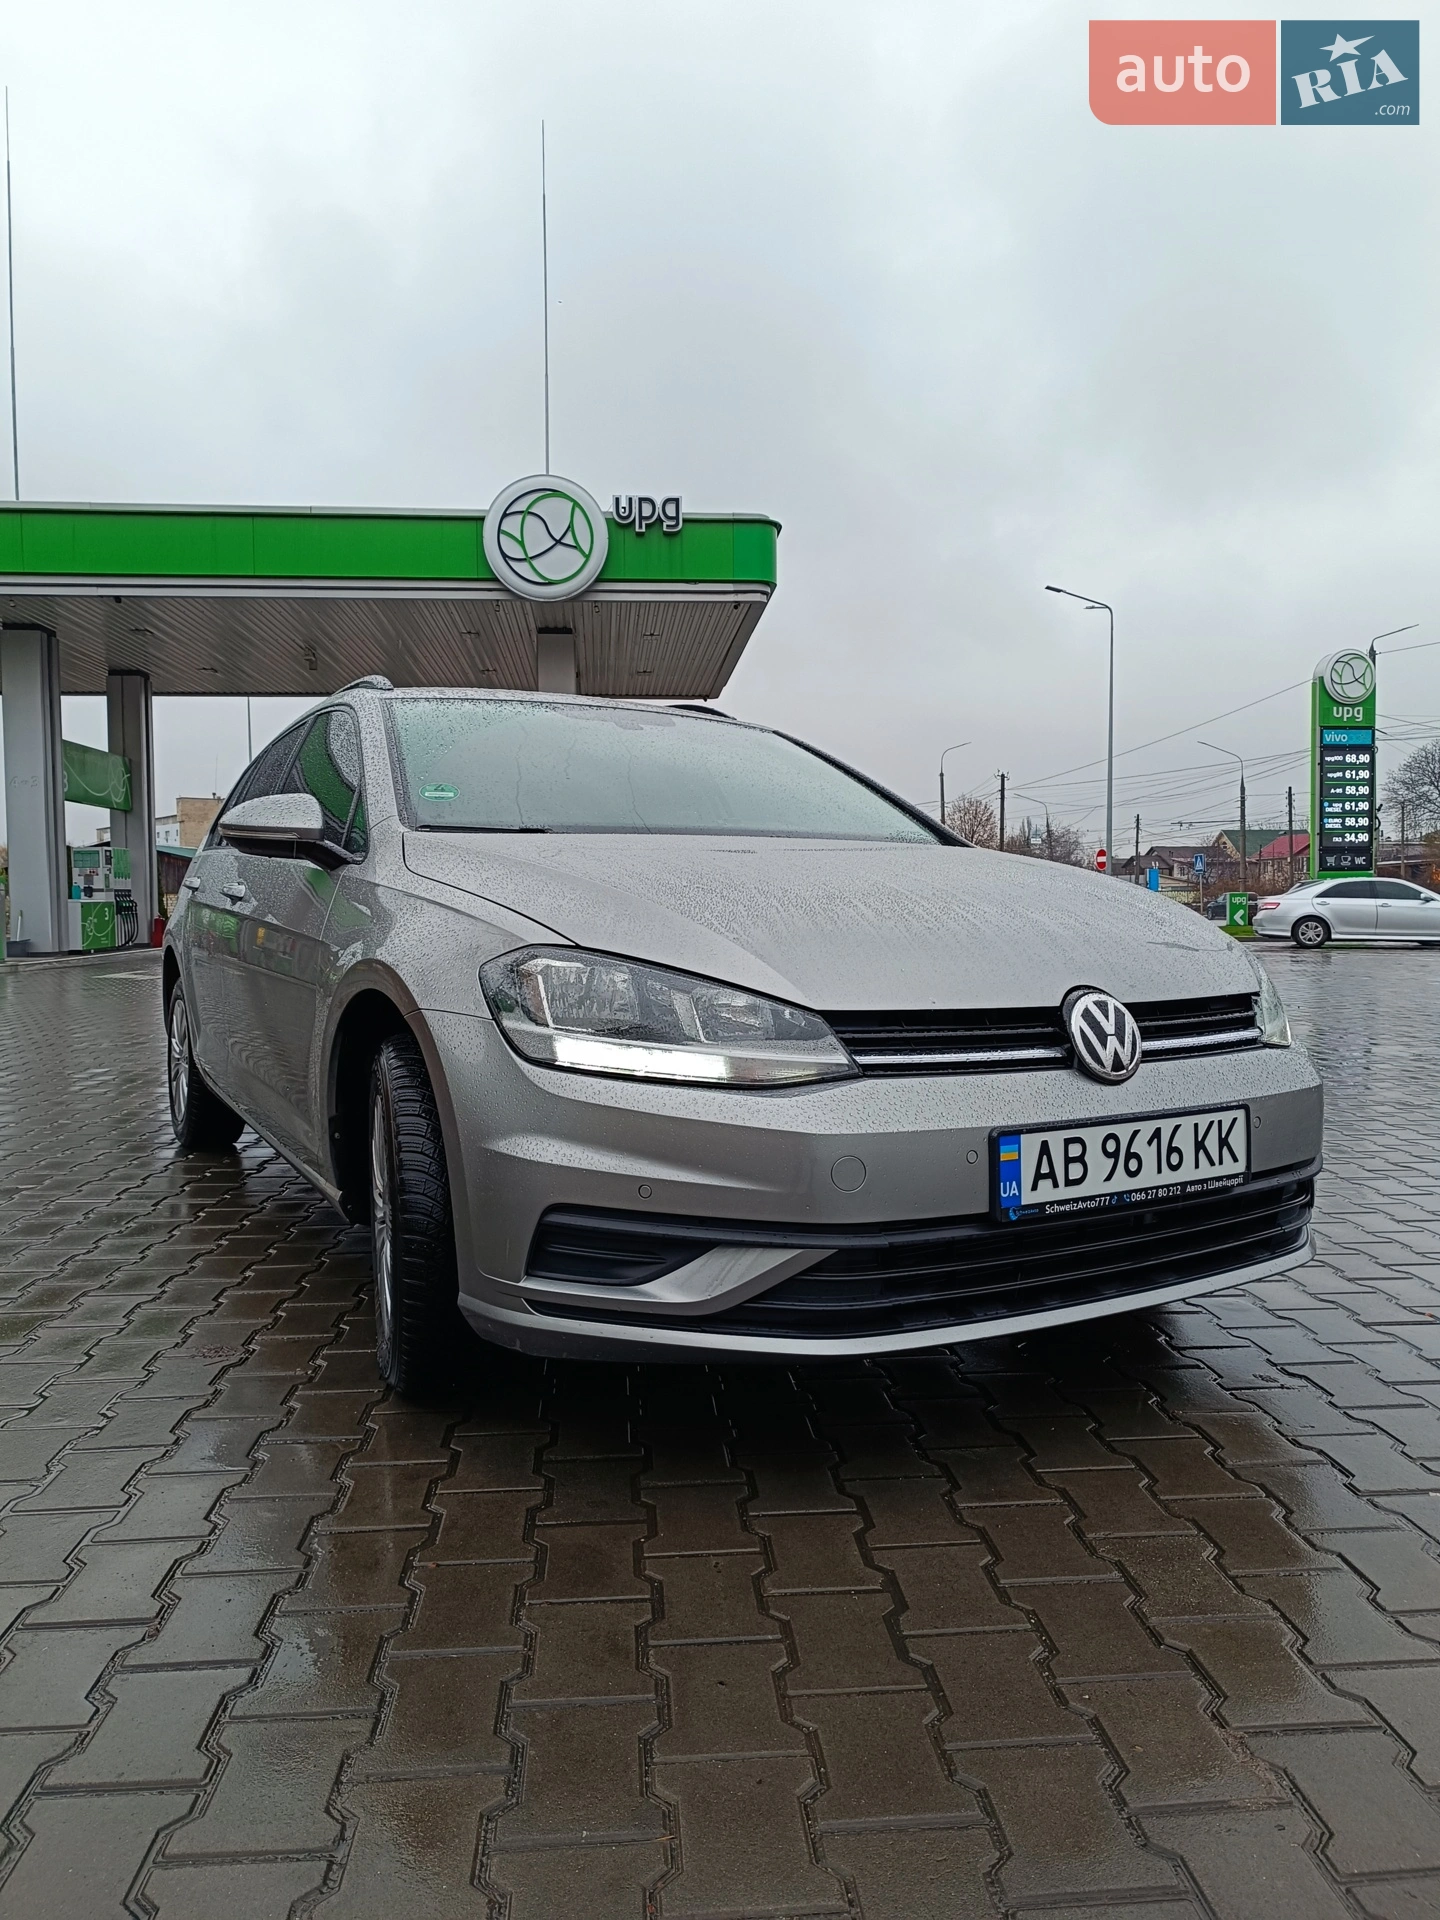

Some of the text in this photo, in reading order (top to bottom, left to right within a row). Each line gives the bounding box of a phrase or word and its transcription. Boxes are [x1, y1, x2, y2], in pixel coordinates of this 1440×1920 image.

[612, 494, 683, 534] upg
[1333, 706, 1363, 722] upg
[1325, 731, 1348, 742] vivo
[1345, 754, 1370, 765] 68,90
[1345, 770, 1370, 780] 61,90
[1345, 786, 1370, 796] 58,90
[1344, 801, 1369, 812] 61,90
[1344, 817, 1369, 828] 58,90
[1344, 833, 1369, 844] 34,90
[1354, 856, 1367, 865] WC
[1231, 896, 1247, 905] upg
[104, 907, 110, 920] 3
[1030, 1116, 1240, 1192] AB 9616 KK
[1000, 1181, 1019, 1197] UA
[1186, 1184, 1202, 1193] Авто
[1045, 1185, 1181, 1214] SchweizAvto777 066 27 80 212
